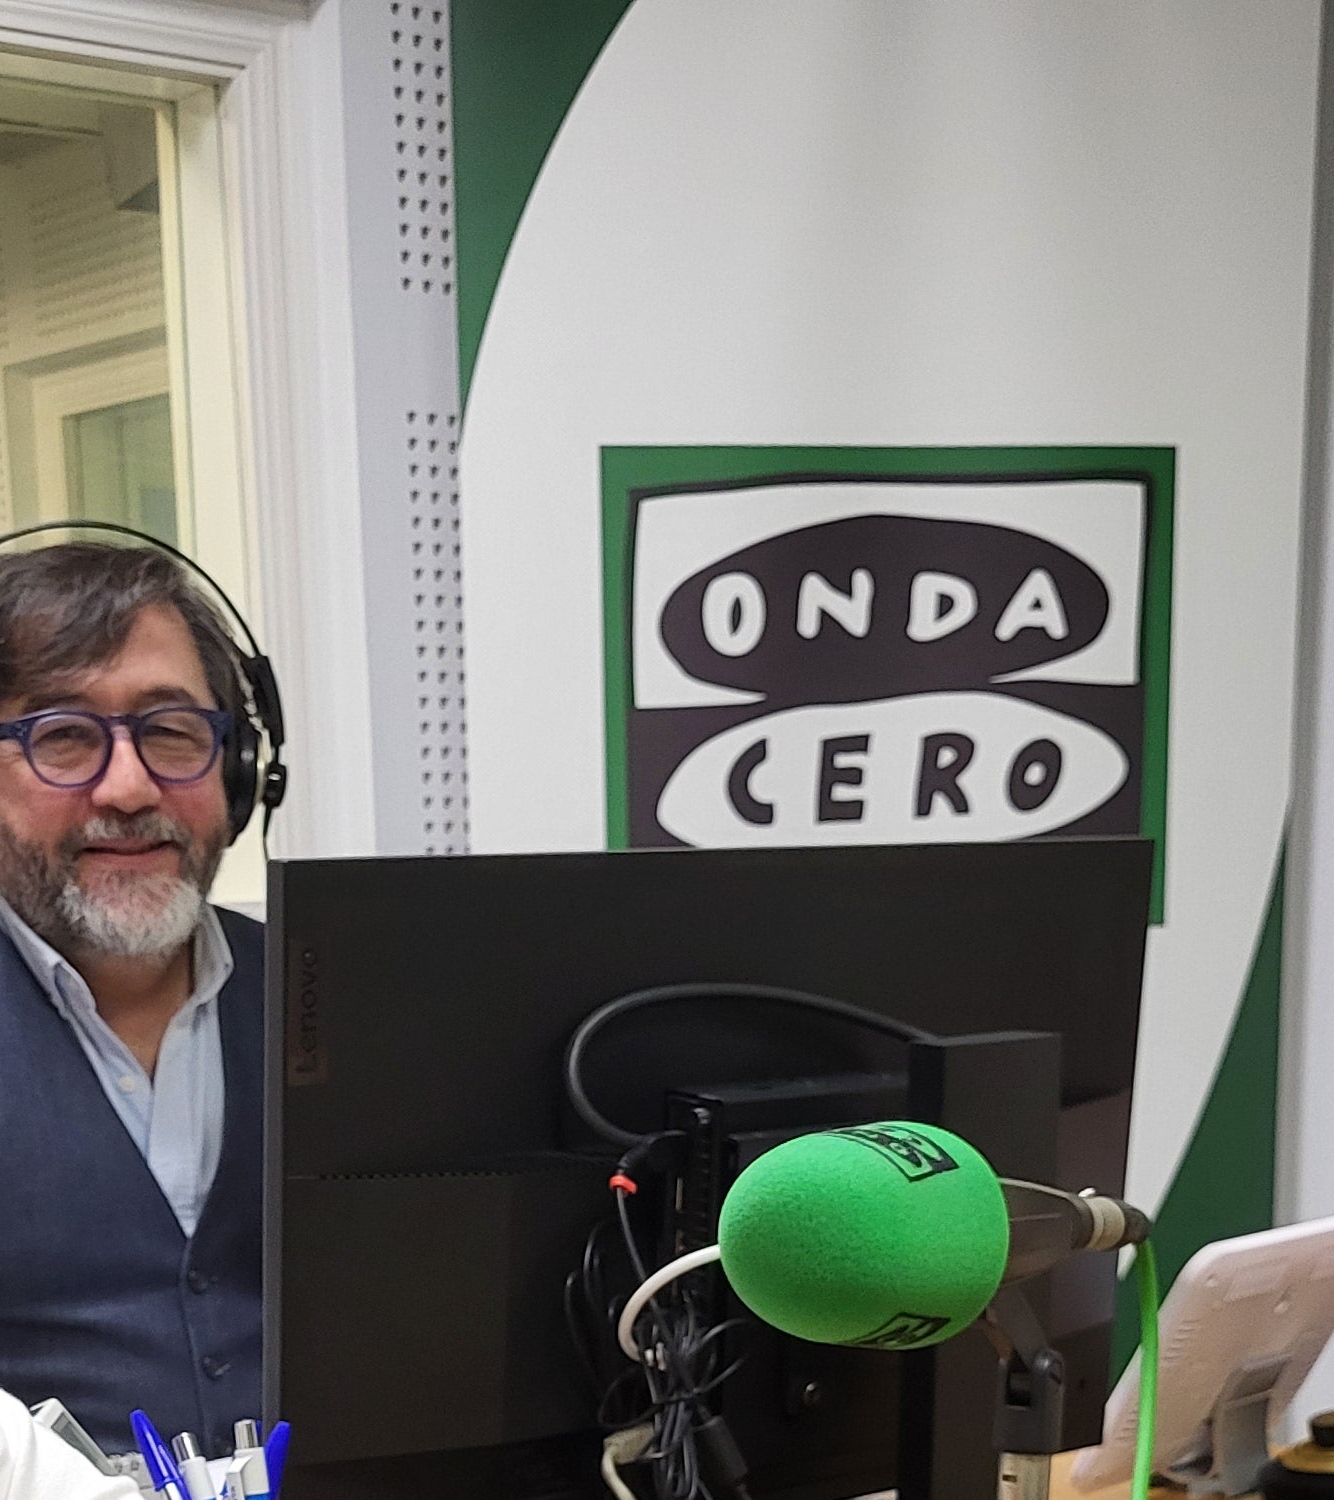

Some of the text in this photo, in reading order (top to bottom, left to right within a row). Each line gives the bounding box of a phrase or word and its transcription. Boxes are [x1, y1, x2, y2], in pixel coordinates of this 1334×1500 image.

[701, 567, 1069, 657] ONDA
[728, 734, 1063, 826] CERO
[295, 948, 317, 1073] Lenovo
